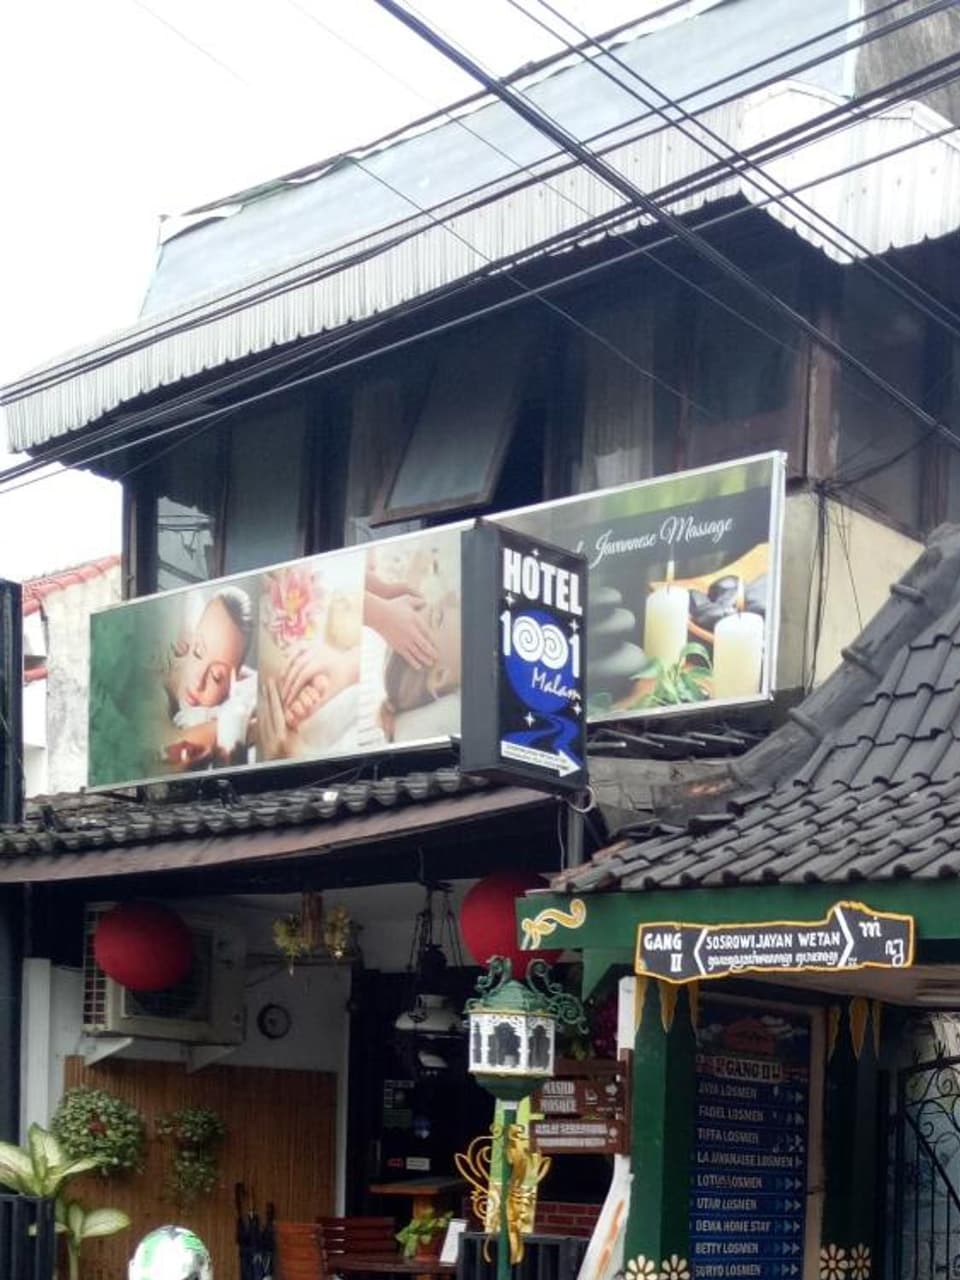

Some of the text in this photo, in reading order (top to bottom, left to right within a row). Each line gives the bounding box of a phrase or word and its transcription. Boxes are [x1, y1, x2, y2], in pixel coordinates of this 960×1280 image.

[660, 515, 733, 546] Massage
[503, 547, 583, 616] HOTEL
[500, 610, 581, 679] 1001
[531, 668, 582, 701] Malam
[643, 932, 682, 951] GANG
[705, 930, 841, 951] SOSROWIJAYAN WETAN
[670, 953, 683, 972] II
[726, 1058, 760, 1079] GANG
[696, 1242, 758, 1255] BETTY LOSMEN
